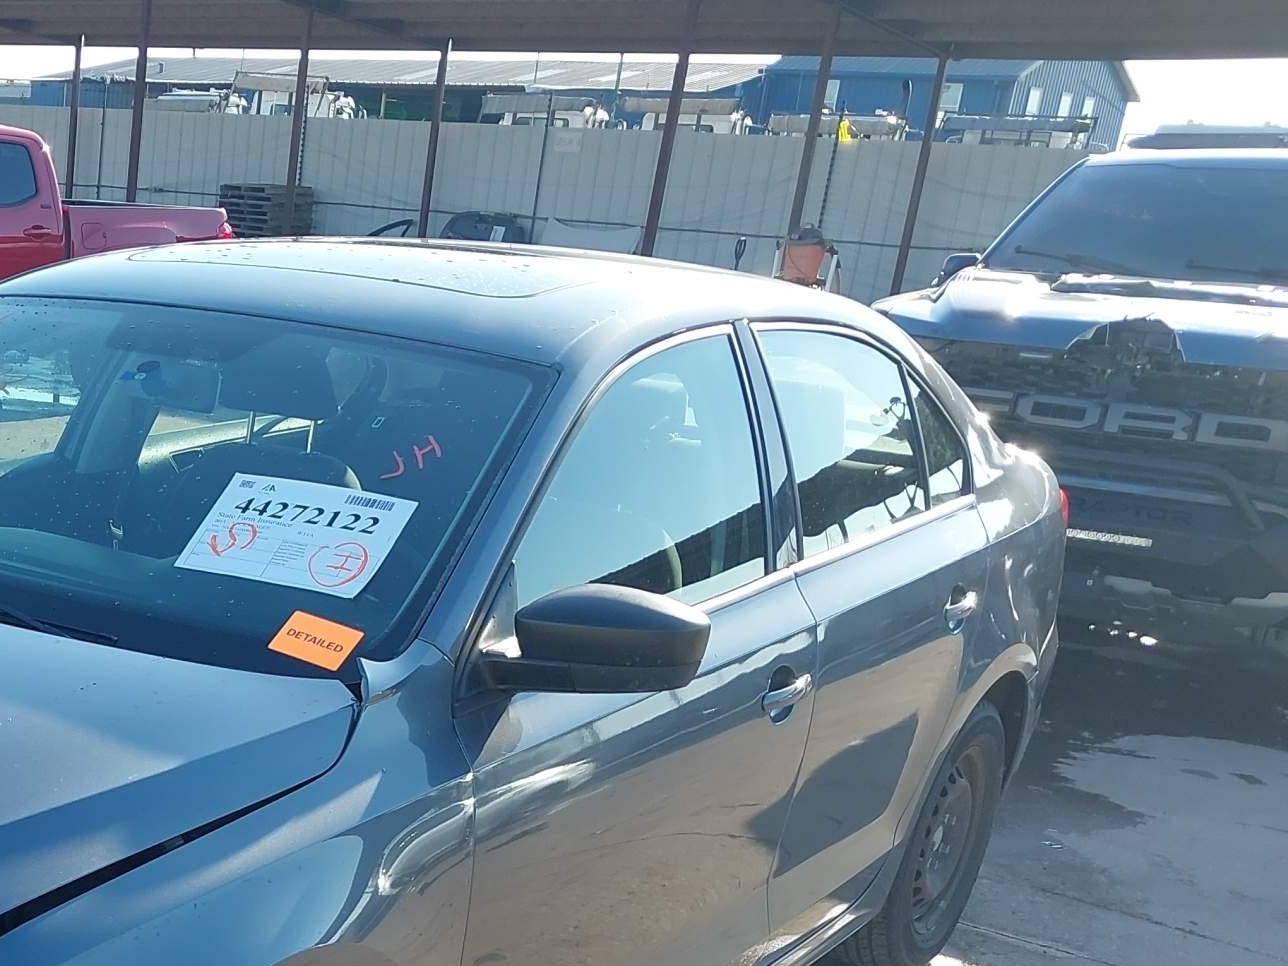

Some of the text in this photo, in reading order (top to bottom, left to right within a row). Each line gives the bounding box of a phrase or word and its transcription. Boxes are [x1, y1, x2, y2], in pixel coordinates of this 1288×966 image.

[965, 387, 1288, 453] FORD
[234, 496, 381, 535] 44272122
[286, 627, 344, 653] DETAILED
